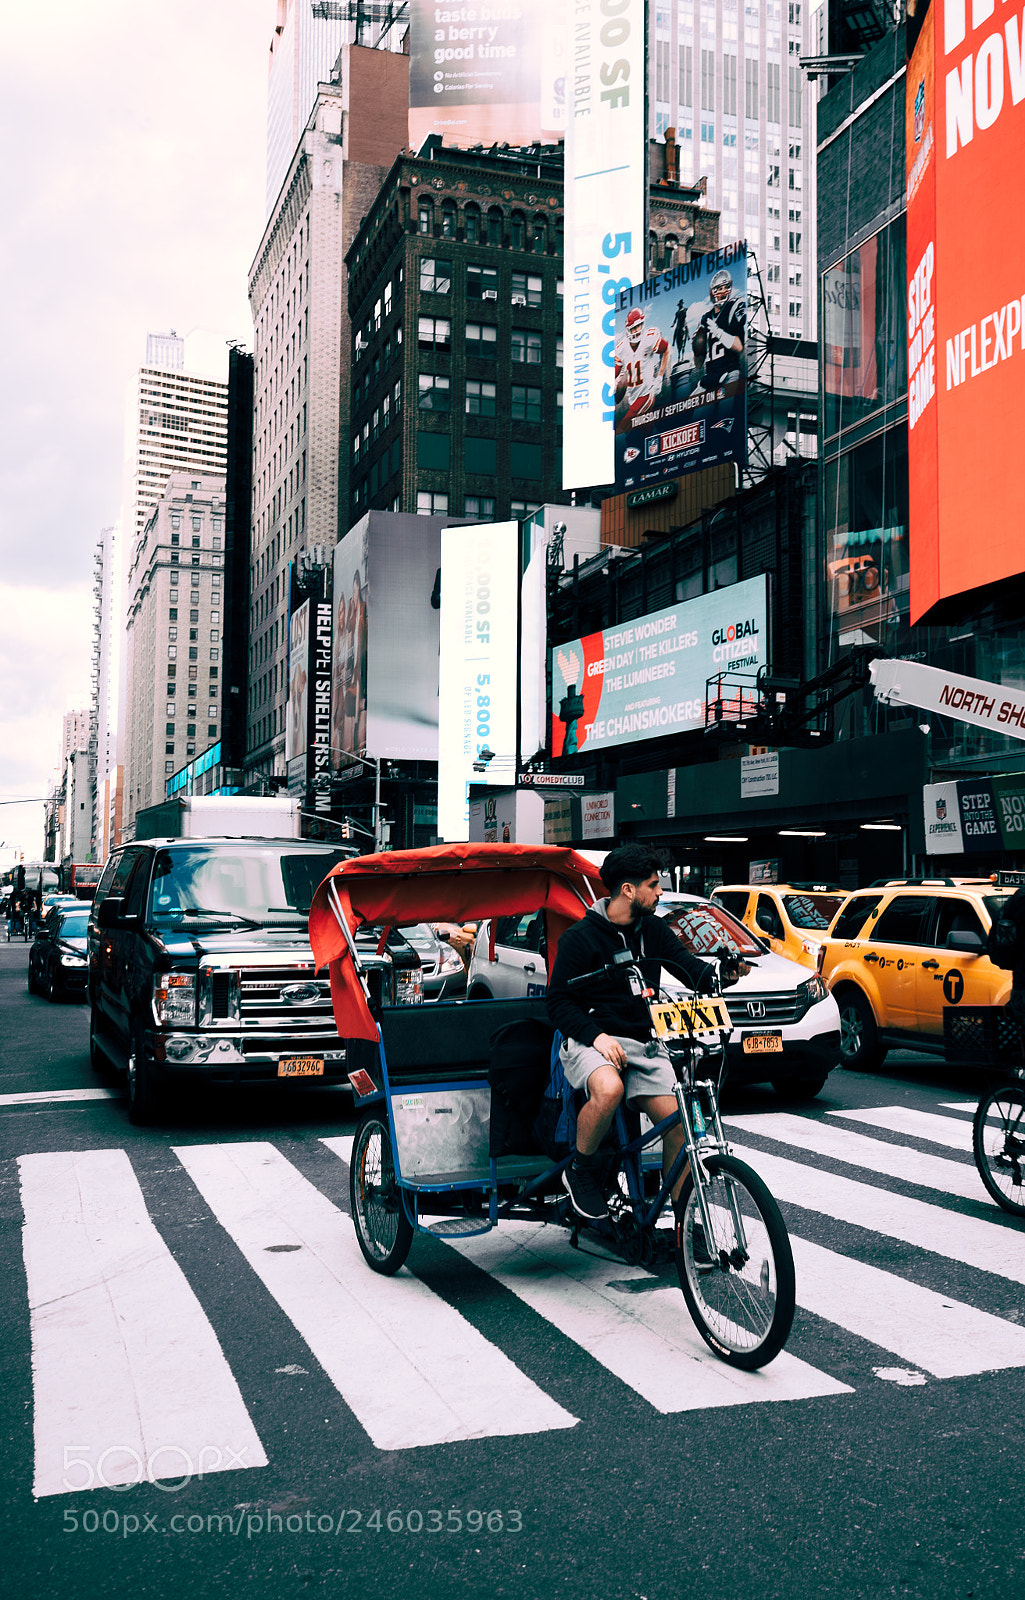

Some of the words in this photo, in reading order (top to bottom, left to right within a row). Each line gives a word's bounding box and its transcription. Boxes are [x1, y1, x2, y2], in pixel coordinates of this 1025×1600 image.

[434, 7, 477, 23] taste
[434, 28, 445, 41] a
[448, 25, 498, 43] berry
[434, 44, 474, 64] good
[478, 42, 517, 58] time
[575, 22, 591, 118] AVAILABLE
[600, 59, 630, 109] SF
[574, 264, 590, 284] OF
[639, 277, 660, 303] THE
[664, 258, 703, 291] SHOW
[706, 238, 747, 274] BEGIN
[908, 241, 934, 339] STEP
[574, 292, 590, 324] LED
[573, 328, 590, 411] SIGNAGE
[631, 411, 660, 428] THURSDAY
[665, 396, 700, 416] SEPTEMBER
[700, 396, 705, 405] 7
[706, 391, 716, 402] ON
[662, 427, 698, 451] KICKOFF
[631, 485, 671, 504] LAMAR
[604, 629, 633, 652] STEVIE
[634, 614, 677, 641] WONDER
[712, 618, 759, 646] GLOBAL
[587, 656, 615, 677] GREEN
[616, 650, 634, 668] DAY
[639, 643, 657, 662] THE
[658, 630, 698, 656] KILLERS
[712, 635, 758, 663] CITIZEN
[728, 655, 758, 671] FESTIVAL
[606, 675, 622, 693] THE
[623, 660, 676, 689] LUMINEERS
[475, 673, 491, 738] 5,800
[939, 684, 997, 718] NORTH
[584, 720, 605, 741] THE
[606, 698, 702, 737] CHAINSMOKERS
[962, 793, 991, 810] STEP
[963, 811, 980, 820] INTO
[981, 809, 994, 819] THE
[965, 820, 997, 835] GAME
